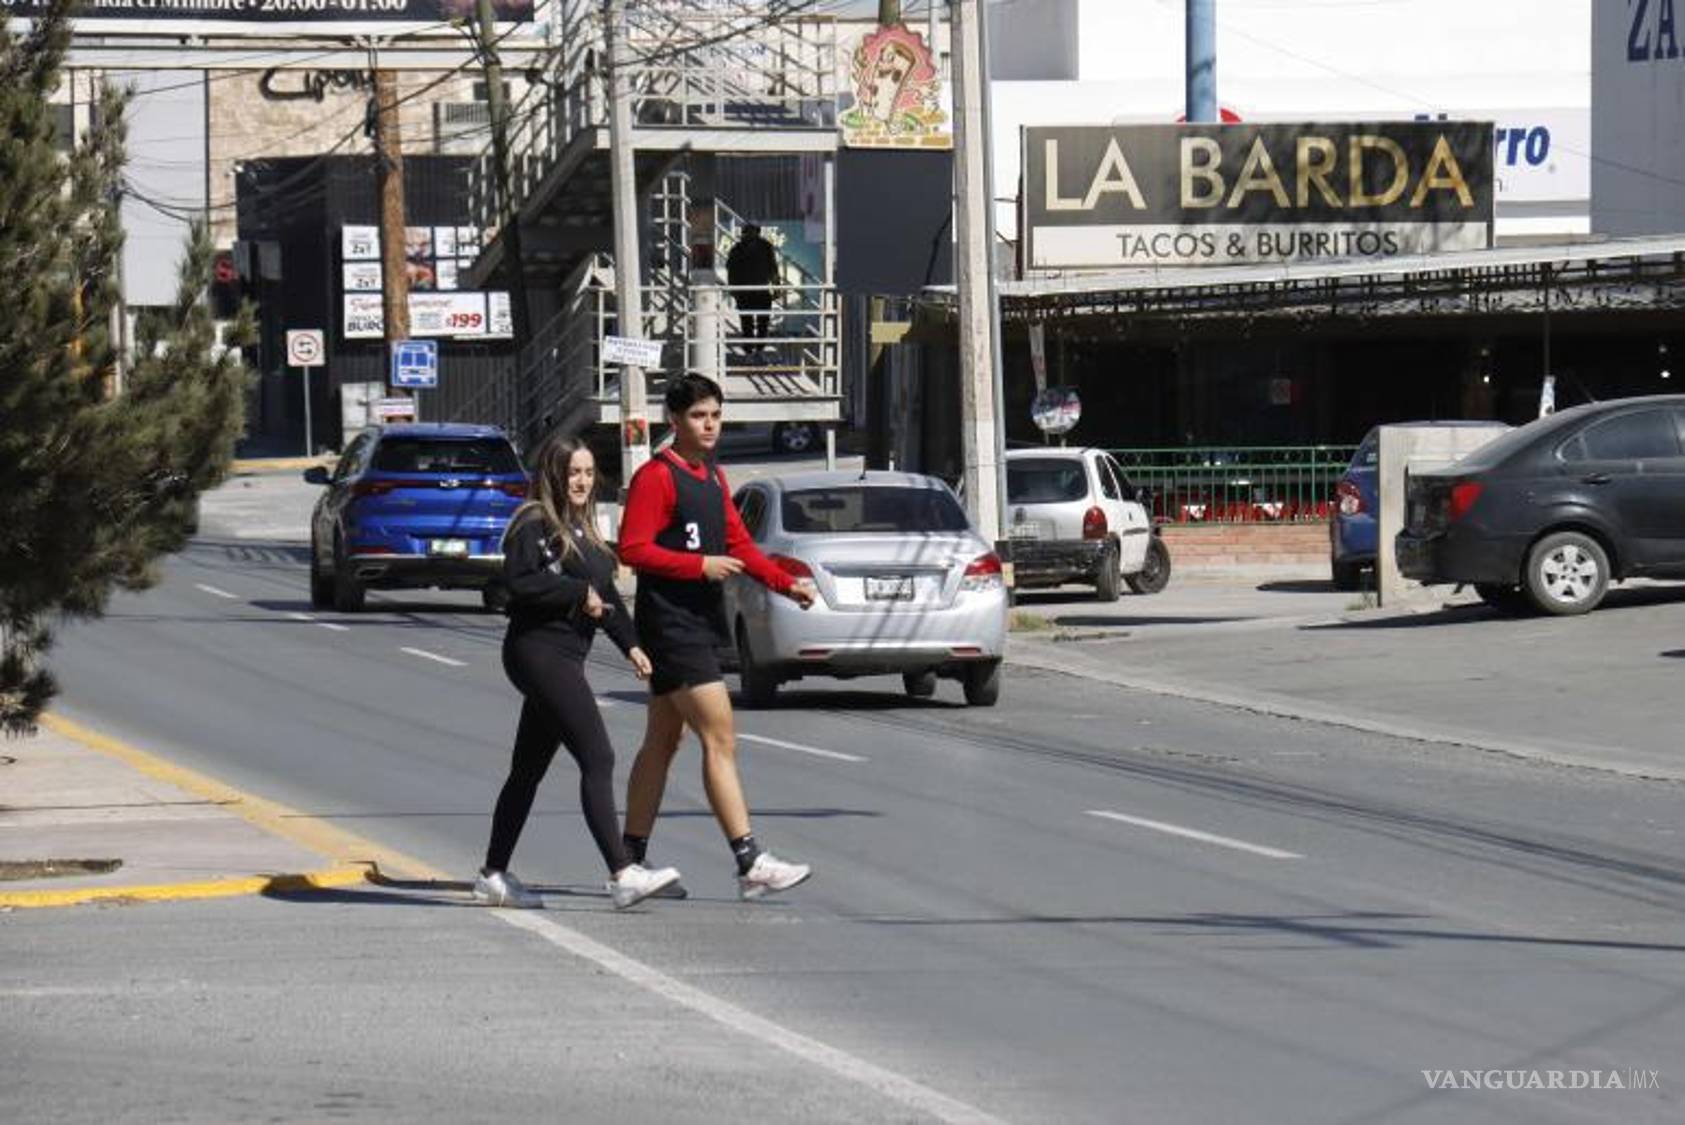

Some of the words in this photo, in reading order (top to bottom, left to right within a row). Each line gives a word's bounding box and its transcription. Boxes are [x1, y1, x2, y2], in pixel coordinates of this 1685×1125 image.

[1045, 135, 1148, 210] LA
[1180, 134, 1475, 209] BARDA
[1115, 232, 1215, 259] TACOS
[1226, 232, 1246, 257] &
[1256, 230, 1398, 257] BURRITOS
[685, 522, 701, 550] 3
